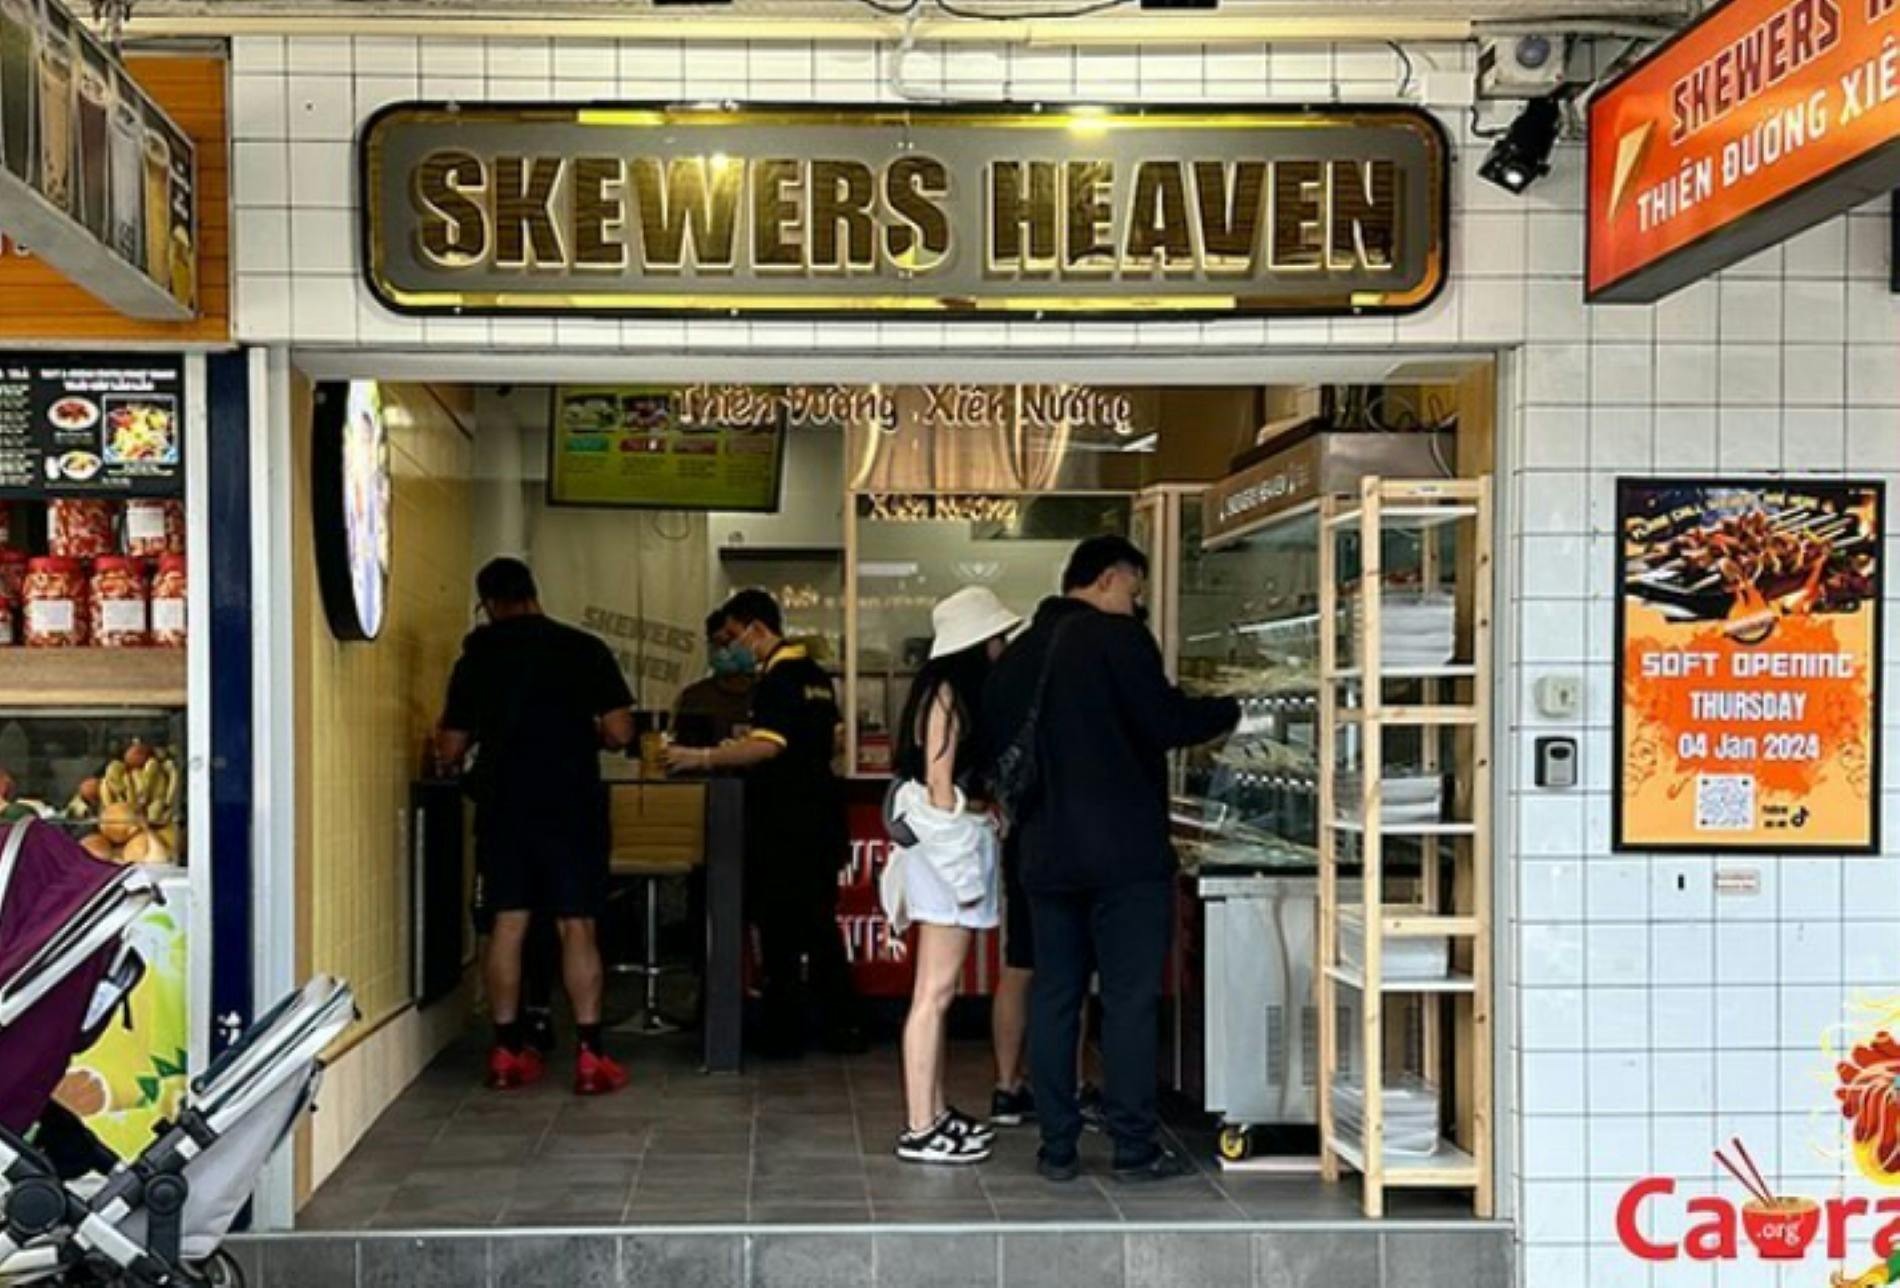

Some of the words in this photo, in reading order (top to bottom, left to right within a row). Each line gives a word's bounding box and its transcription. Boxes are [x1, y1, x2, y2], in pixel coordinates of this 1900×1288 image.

[1669, 0, 1840, 147] SKEWERS
[412, 153, 949, 271] SKEWERS
[987, 158, 1397, 271] HEAVEN
[1636, 156, 1713, 233] THIÊN
[1641, 652, 1719, 677] SOFT
[1731, 653, 1855, 679] OPENING
[1689, 691, 1807, 721] THURSDAY
[1677, 732, 1709, 760] 04
[1714, 733, 1757, 761] Jan
[1762, 732, 1820, 762] 2024
